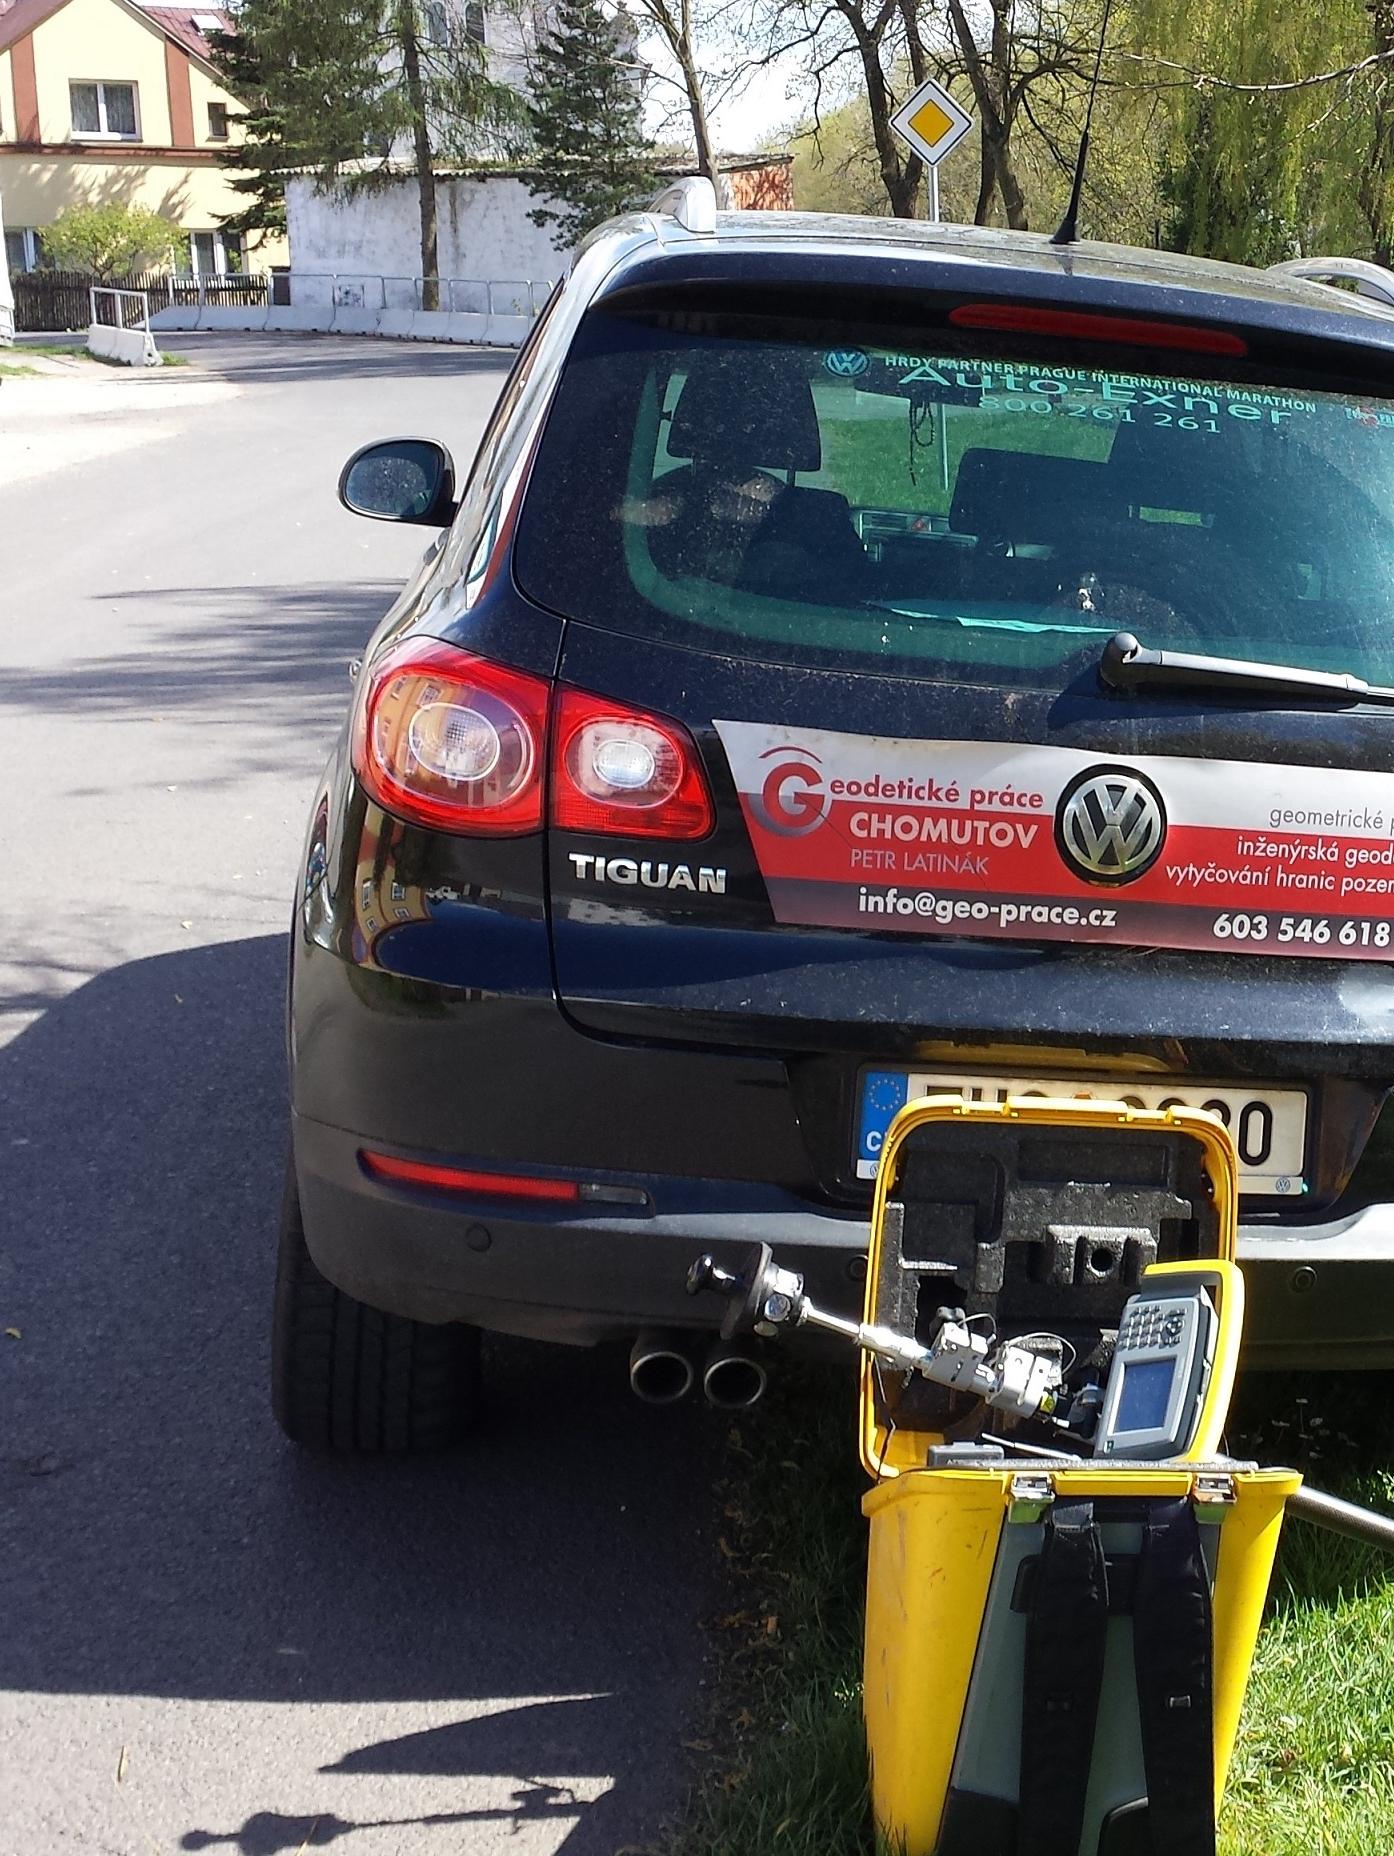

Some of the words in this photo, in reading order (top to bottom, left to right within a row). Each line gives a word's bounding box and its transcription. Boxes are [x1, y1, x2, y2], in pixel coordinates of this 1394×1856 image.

[899, 365, 1292, 425] Auto-Exner
[1018, 364, 1086, 381] PRAGUE
[1092, 372, 1222, 398] INTERNATIONAL
[1226, 388, 1317, 413] MARATHON
[978, 396, 1052, 414] 800
[1067, 403, 1136, 423] 261
[1153, 412, 1221, 434] 261
[969, 784, 1044, 811] práce
[849, 811, 1039, 849] CHOMUTOV
[1269, 807, 1384, 830] geometrické
[850, 848, 897, 870] PETR
[903, 851, 990, 875] LATINÁK
[1237, 835, 1339, 865] inženýrská
[568, 852, 727, 894] TIGUAN
[1165, 861, 1271, 888] vytyčování
[1276, 864, 1336, 892] hranic
[858, 886, 1118, 928] info@geo-prace.cz
[1212, 913, 1269, 940] 603
[1276, 917, 1332, 945] 546
[1338, 920, 1391, 948] 618
[866, 1130, 888, 1152] C
